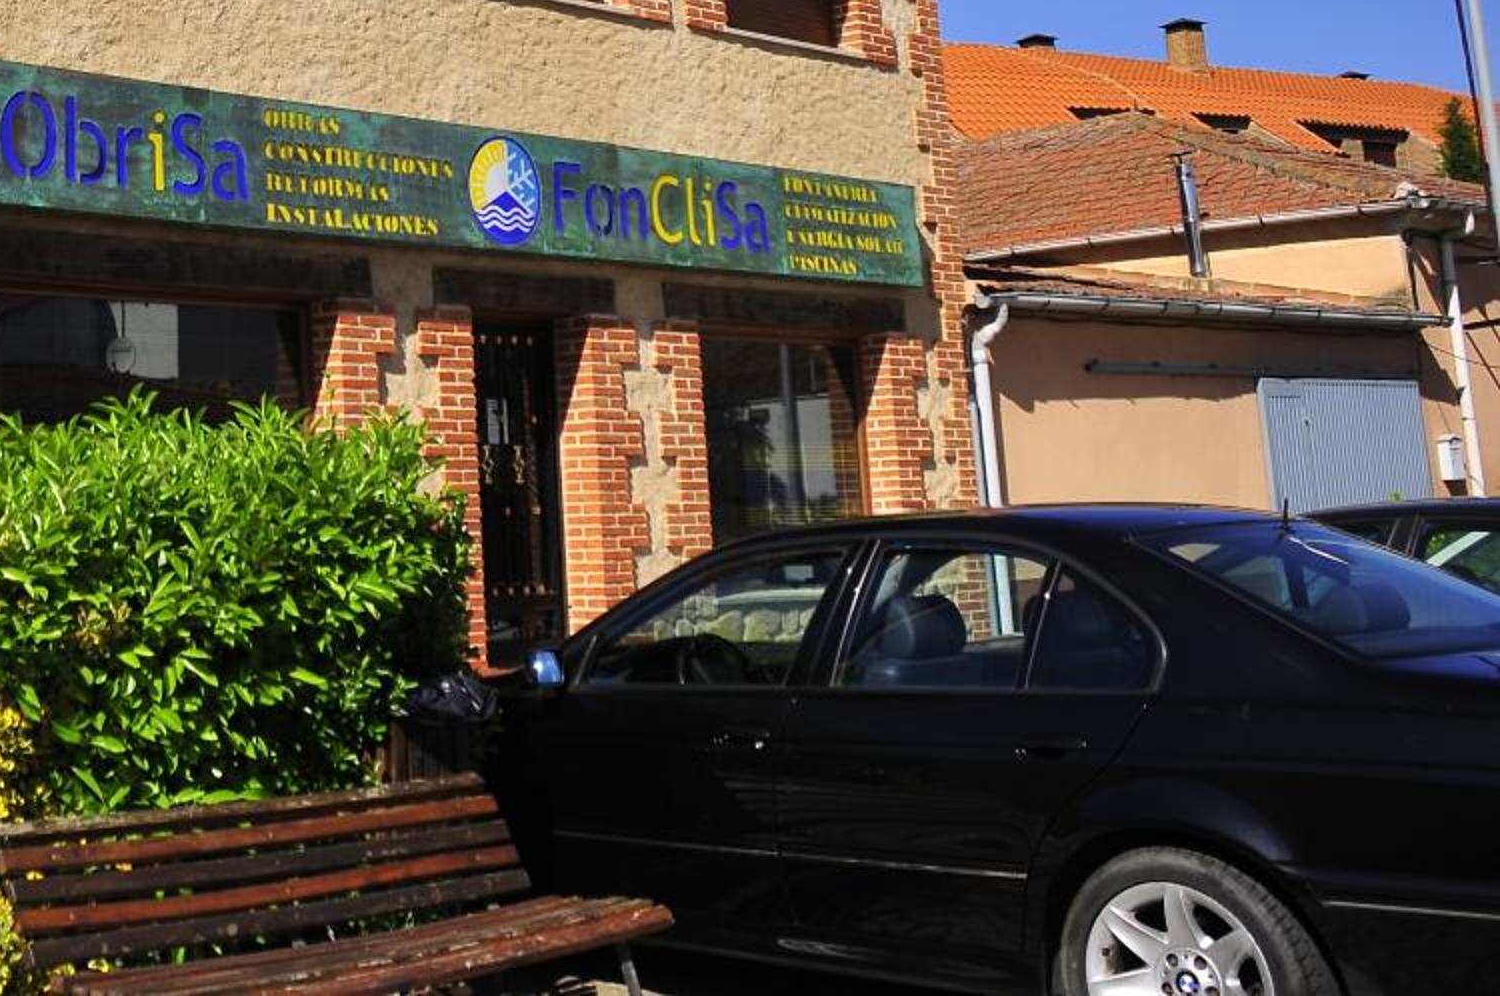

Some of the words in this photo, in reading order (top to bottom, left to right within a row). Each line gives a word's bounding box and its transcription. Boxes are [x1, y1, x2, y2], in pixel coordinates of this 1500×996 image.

[262, 107, 341, 136] OBRAS
[0, 90, 250, 202] ObriSa
[263, 139, 454, 180] CONSTRUCCIONES
[265, 171, 389, 202] REFORMAS
[266, 203, 439, 236] INSTALACIONES
[553, 161, 771, 253] FonCliSa
[789, 254, 857, 275] PISCINAS
